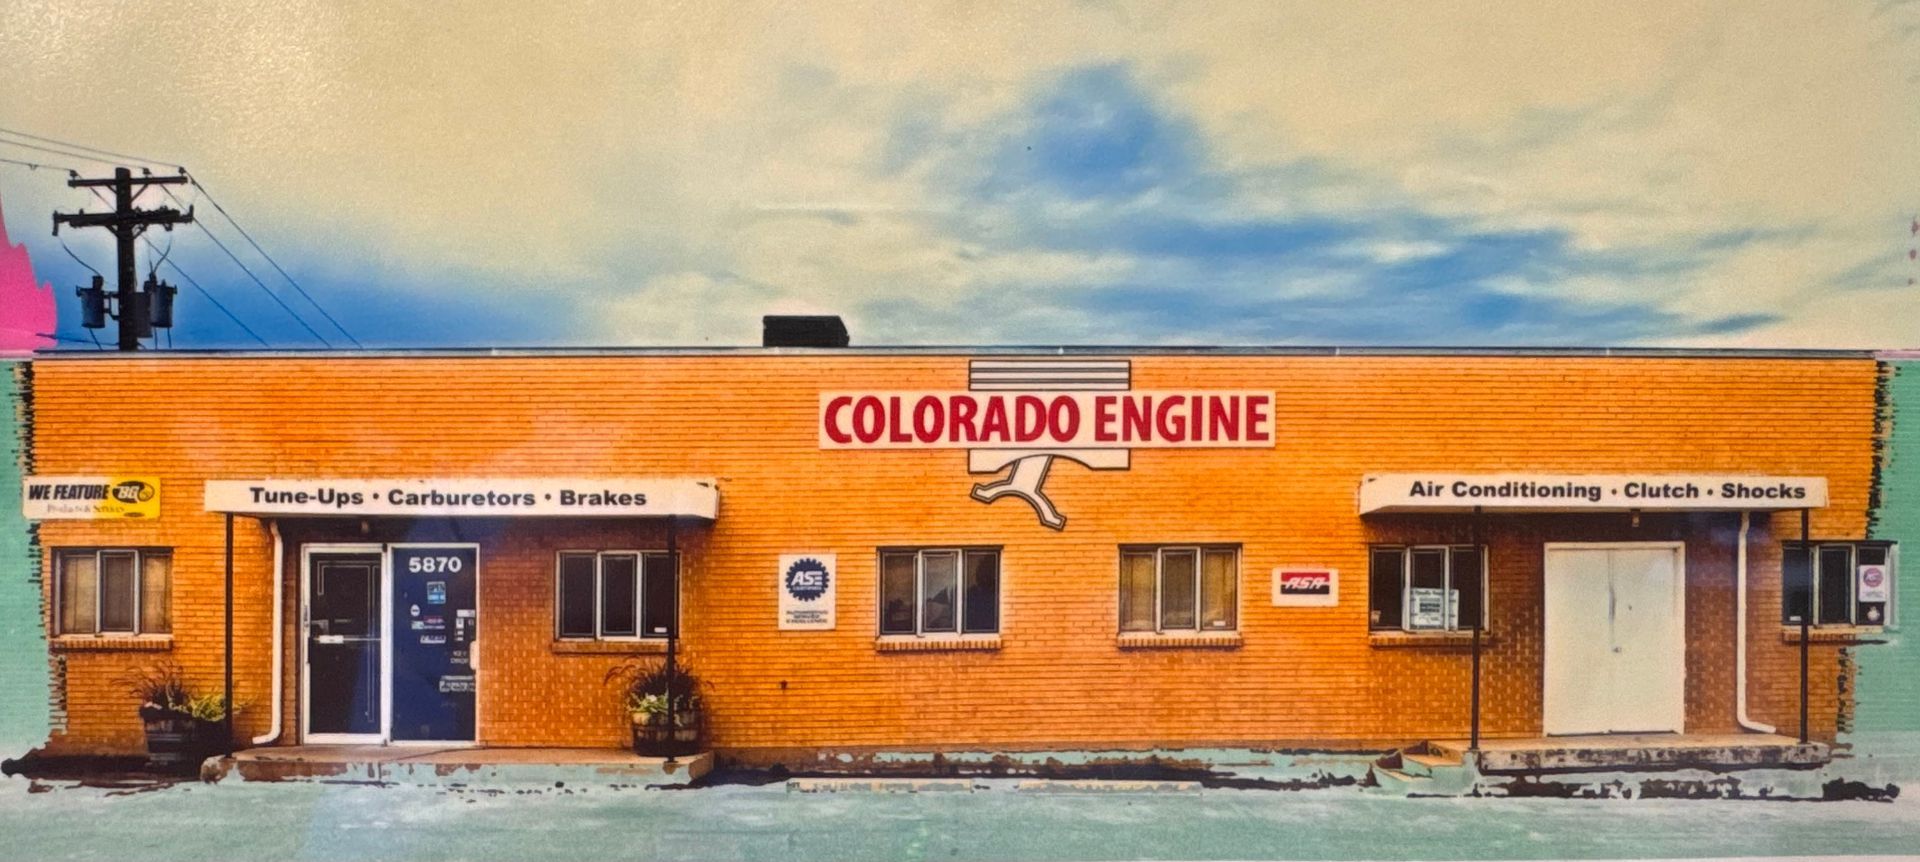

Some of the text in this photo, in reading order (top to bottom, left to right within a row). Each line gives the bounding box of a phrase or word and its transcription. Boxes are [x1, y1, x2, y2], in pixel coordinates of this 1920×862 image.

[824, 395, 1269, 444] COLORADO ENGINE
[29, 484, 51, 500] WE
[53, 484, 110, 500] FEATURE
[250, 487, 647, 508] Tune-Ups Carburetors Brakes
[1409, 481, 1806, 502] Air Conditioning Clutch Shocks
[409, 556, 462, 573] 5870
[791, 571, 823, 586] ASE
